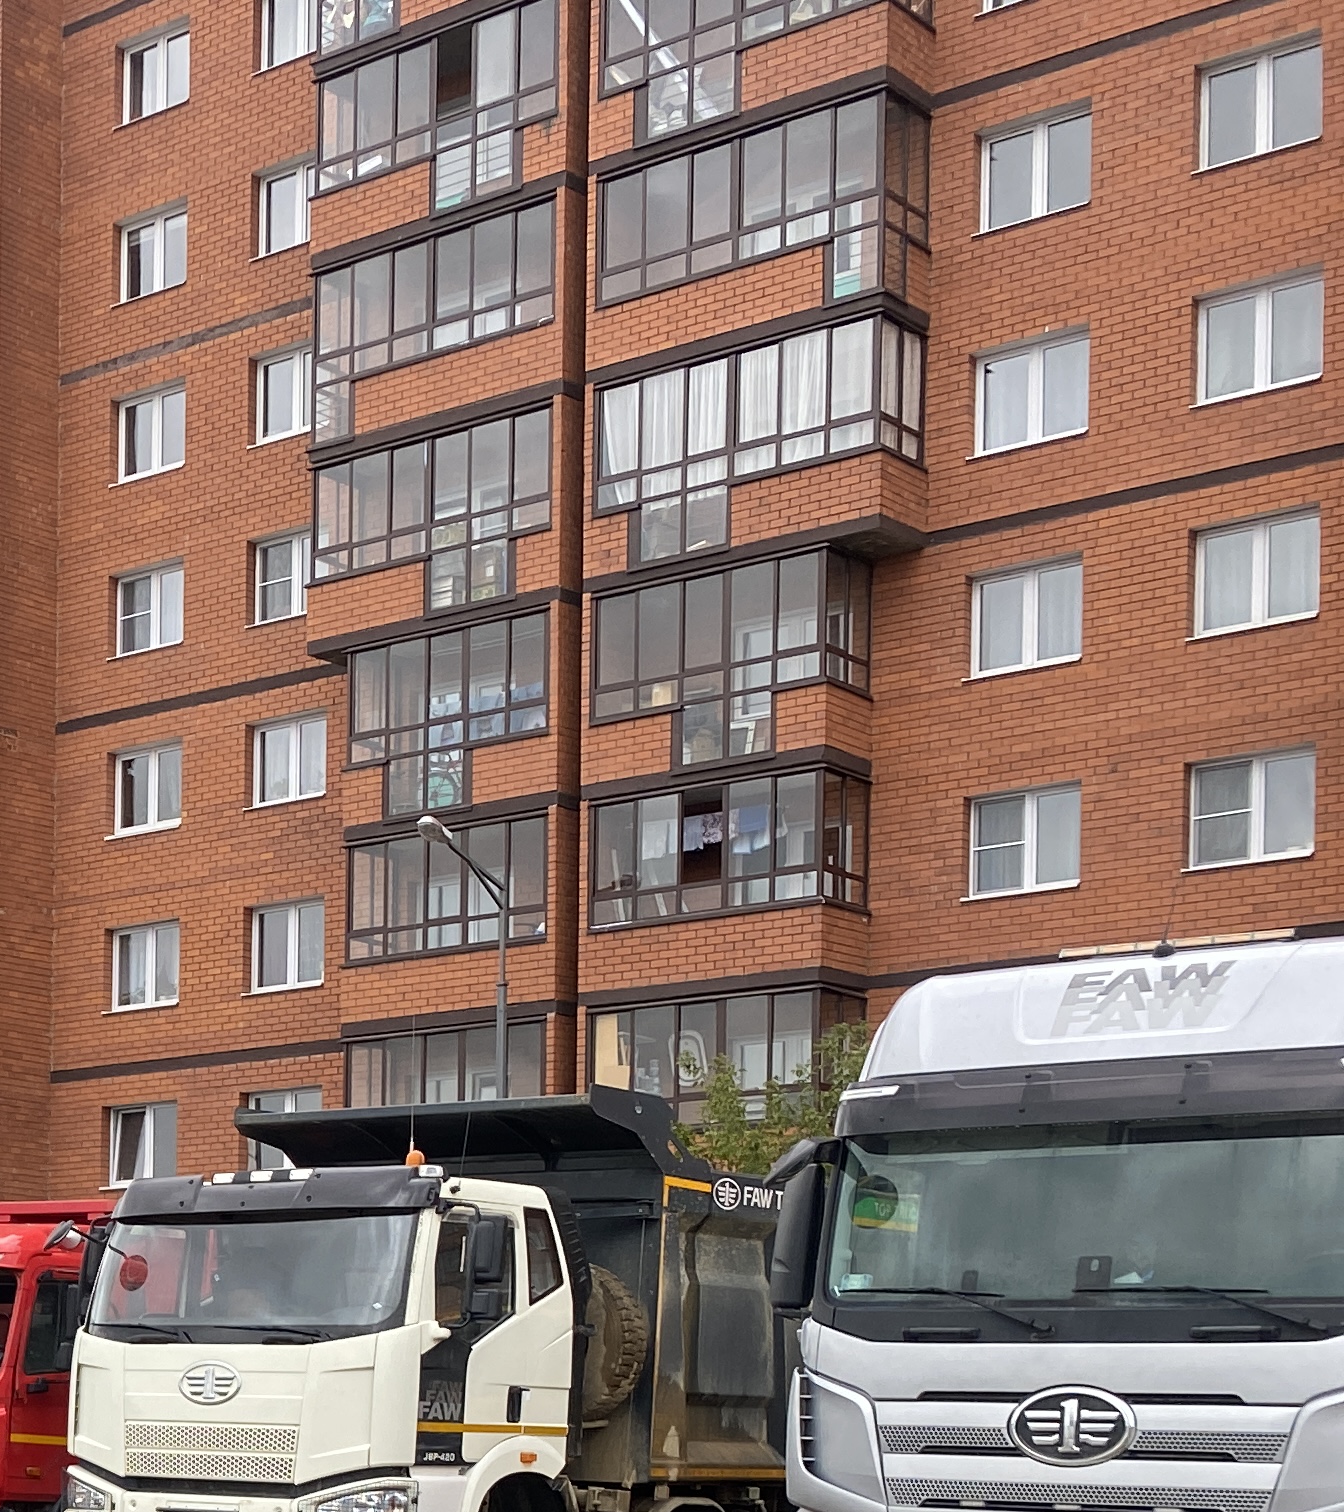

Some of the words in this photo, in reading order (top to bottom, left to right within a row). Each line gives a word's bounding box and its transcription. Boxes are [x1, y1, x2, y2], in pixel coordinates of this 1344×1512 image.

[1060, 975, 1231, 1015] FAW
[1066, 960, 1238, 996] FAW
[1050, 993, 1224, 1037] FAW
[743, 1186, 774, 1209] FAW
[418, 1401, 462, 1420] FAW
